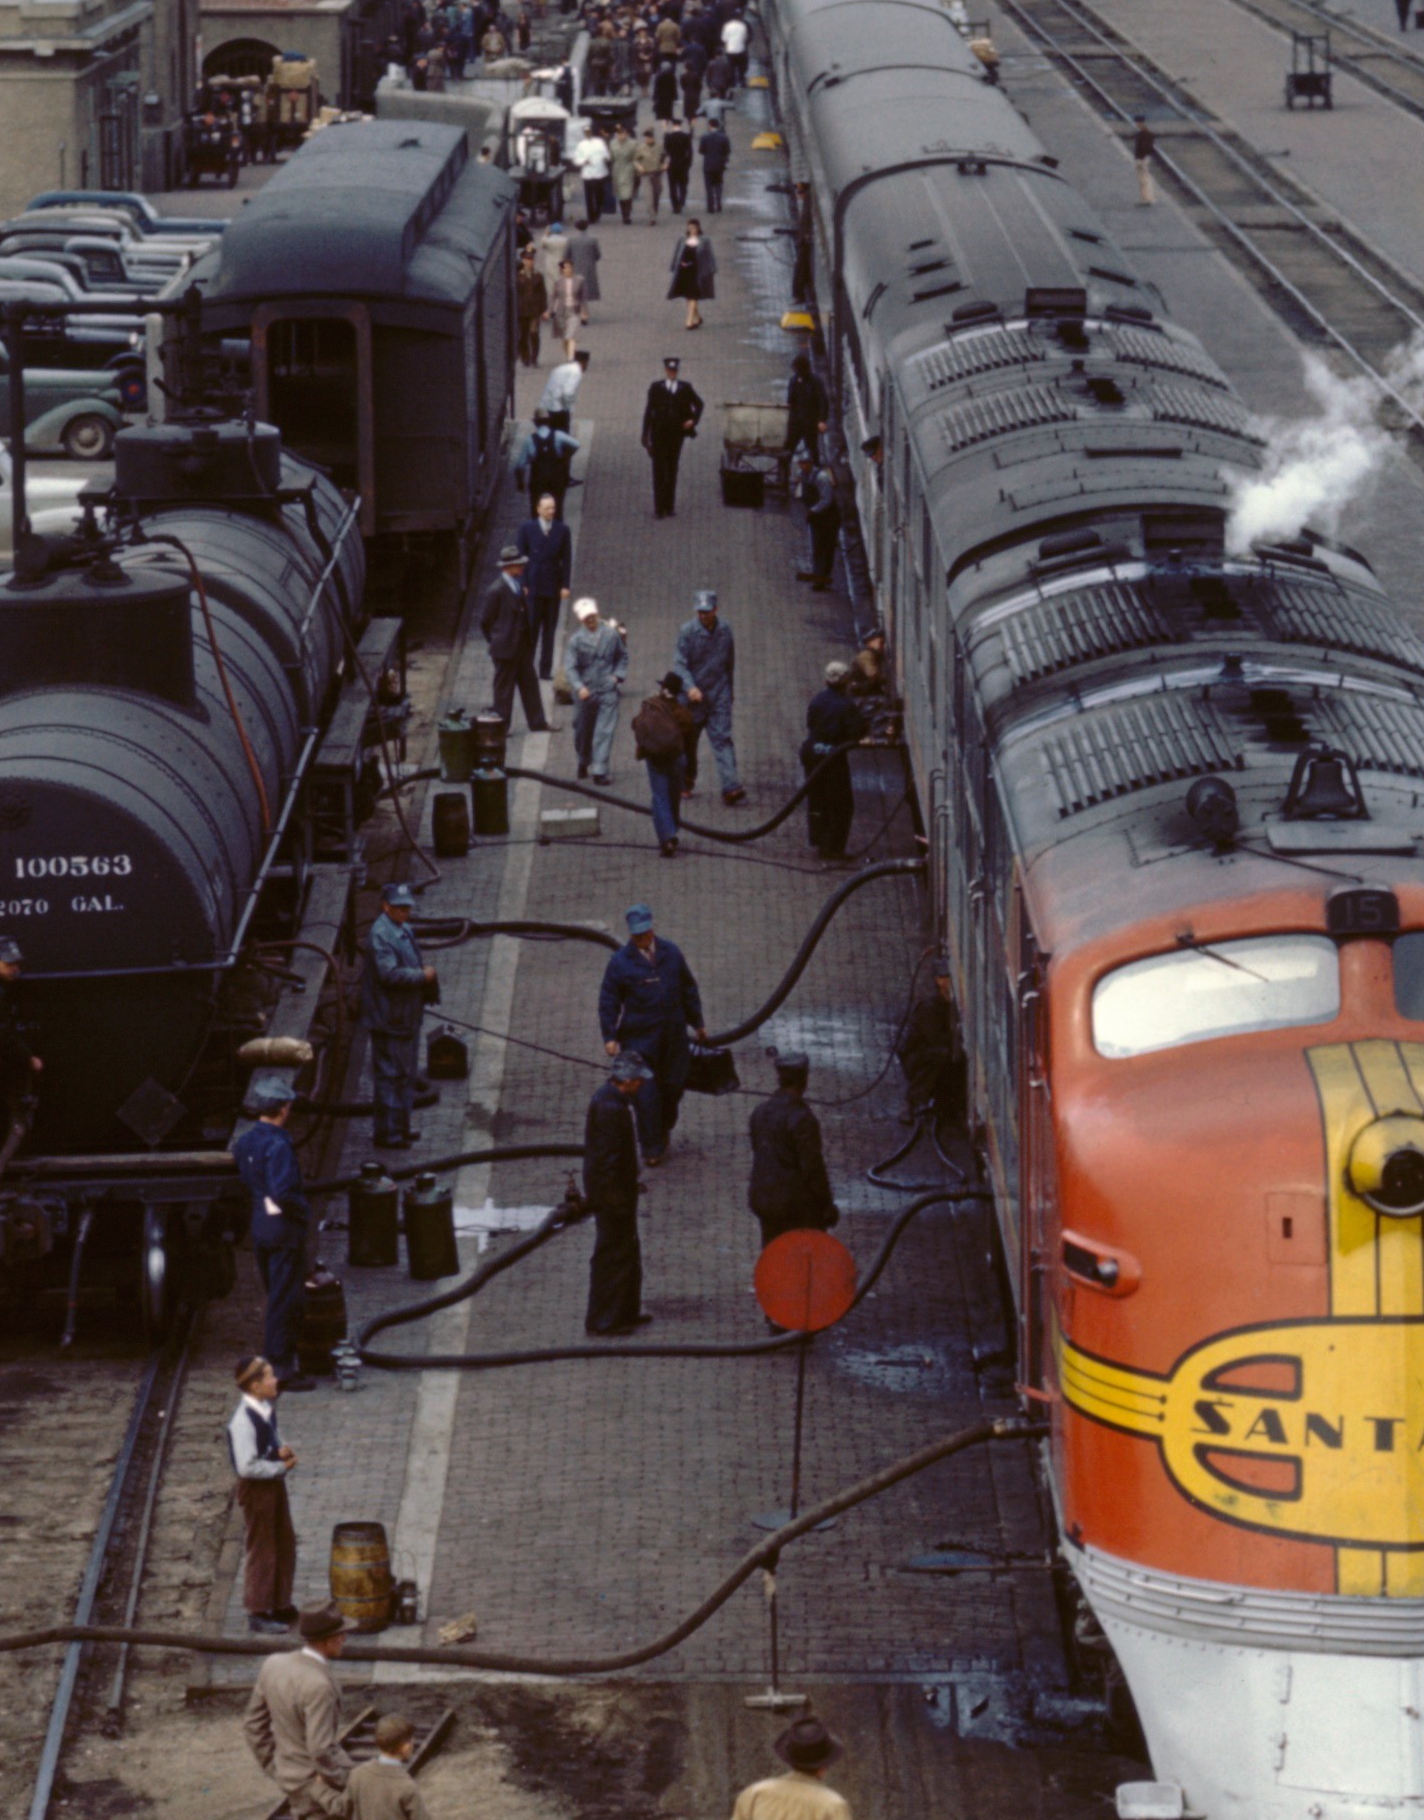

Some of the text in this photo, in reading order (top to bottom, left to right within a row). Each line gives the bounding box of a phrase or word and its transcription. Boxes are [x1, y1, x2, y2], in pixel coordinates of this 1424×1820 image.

[15, 854, 133, 879] 100563
[70, 894, 125, 913] GAL.
[1344, 896, 1382, 927] 15
